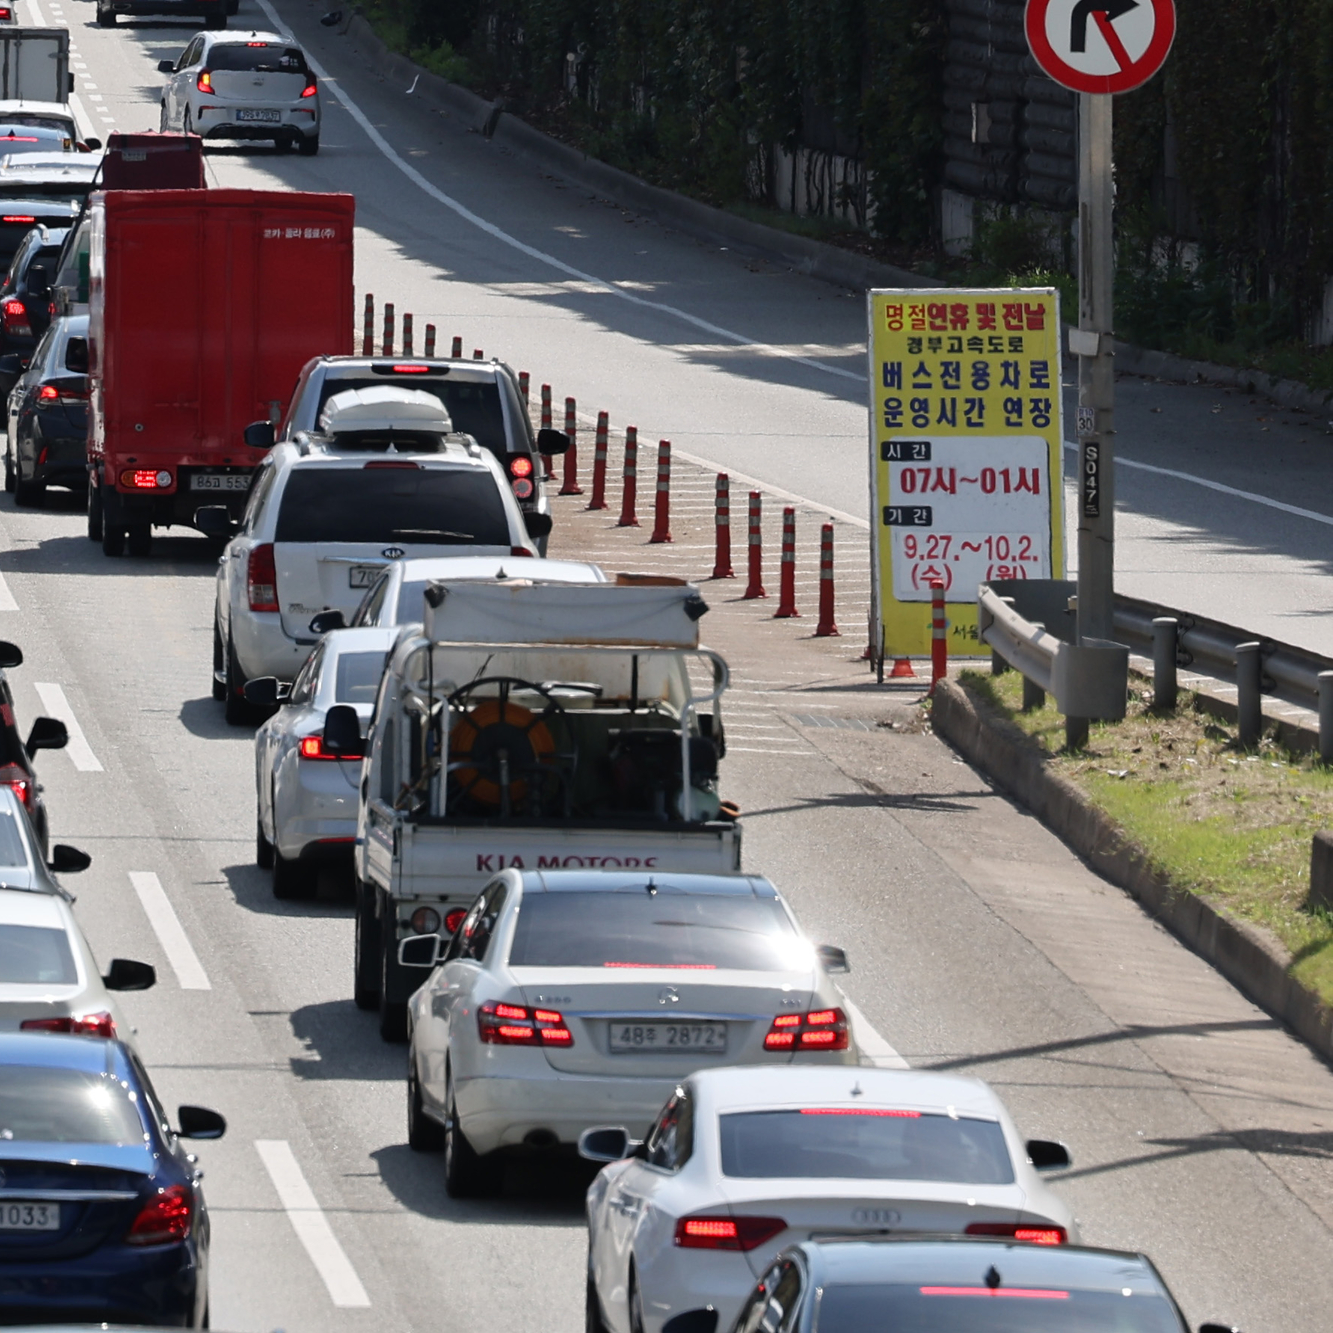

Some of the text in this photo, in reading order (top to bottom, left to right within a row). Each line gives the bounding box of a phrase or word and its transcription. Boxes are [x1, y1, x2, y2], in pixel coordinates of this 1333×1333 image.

[886, 303, 1046, 332] 명절연휴 및 전날
[907, 336, 1024, 354] 경부고속도로
[883, 360, 1051, 391] 버스전용차로
[883, 397, 1052, 429] 운영시간 연장
[1078, 417, 1093, 431] 30
[887, 444, 926, 460] 시간
[226, 476, 251, 489] 553
[900, 467, 1041, 495] 07시~01시
[1085, 446, 1098, 503] S047
[888, 508, 927, 524] 기간
[476, 853, 525, 872] KIA
[666, 1026, 716, 1045] 2872
